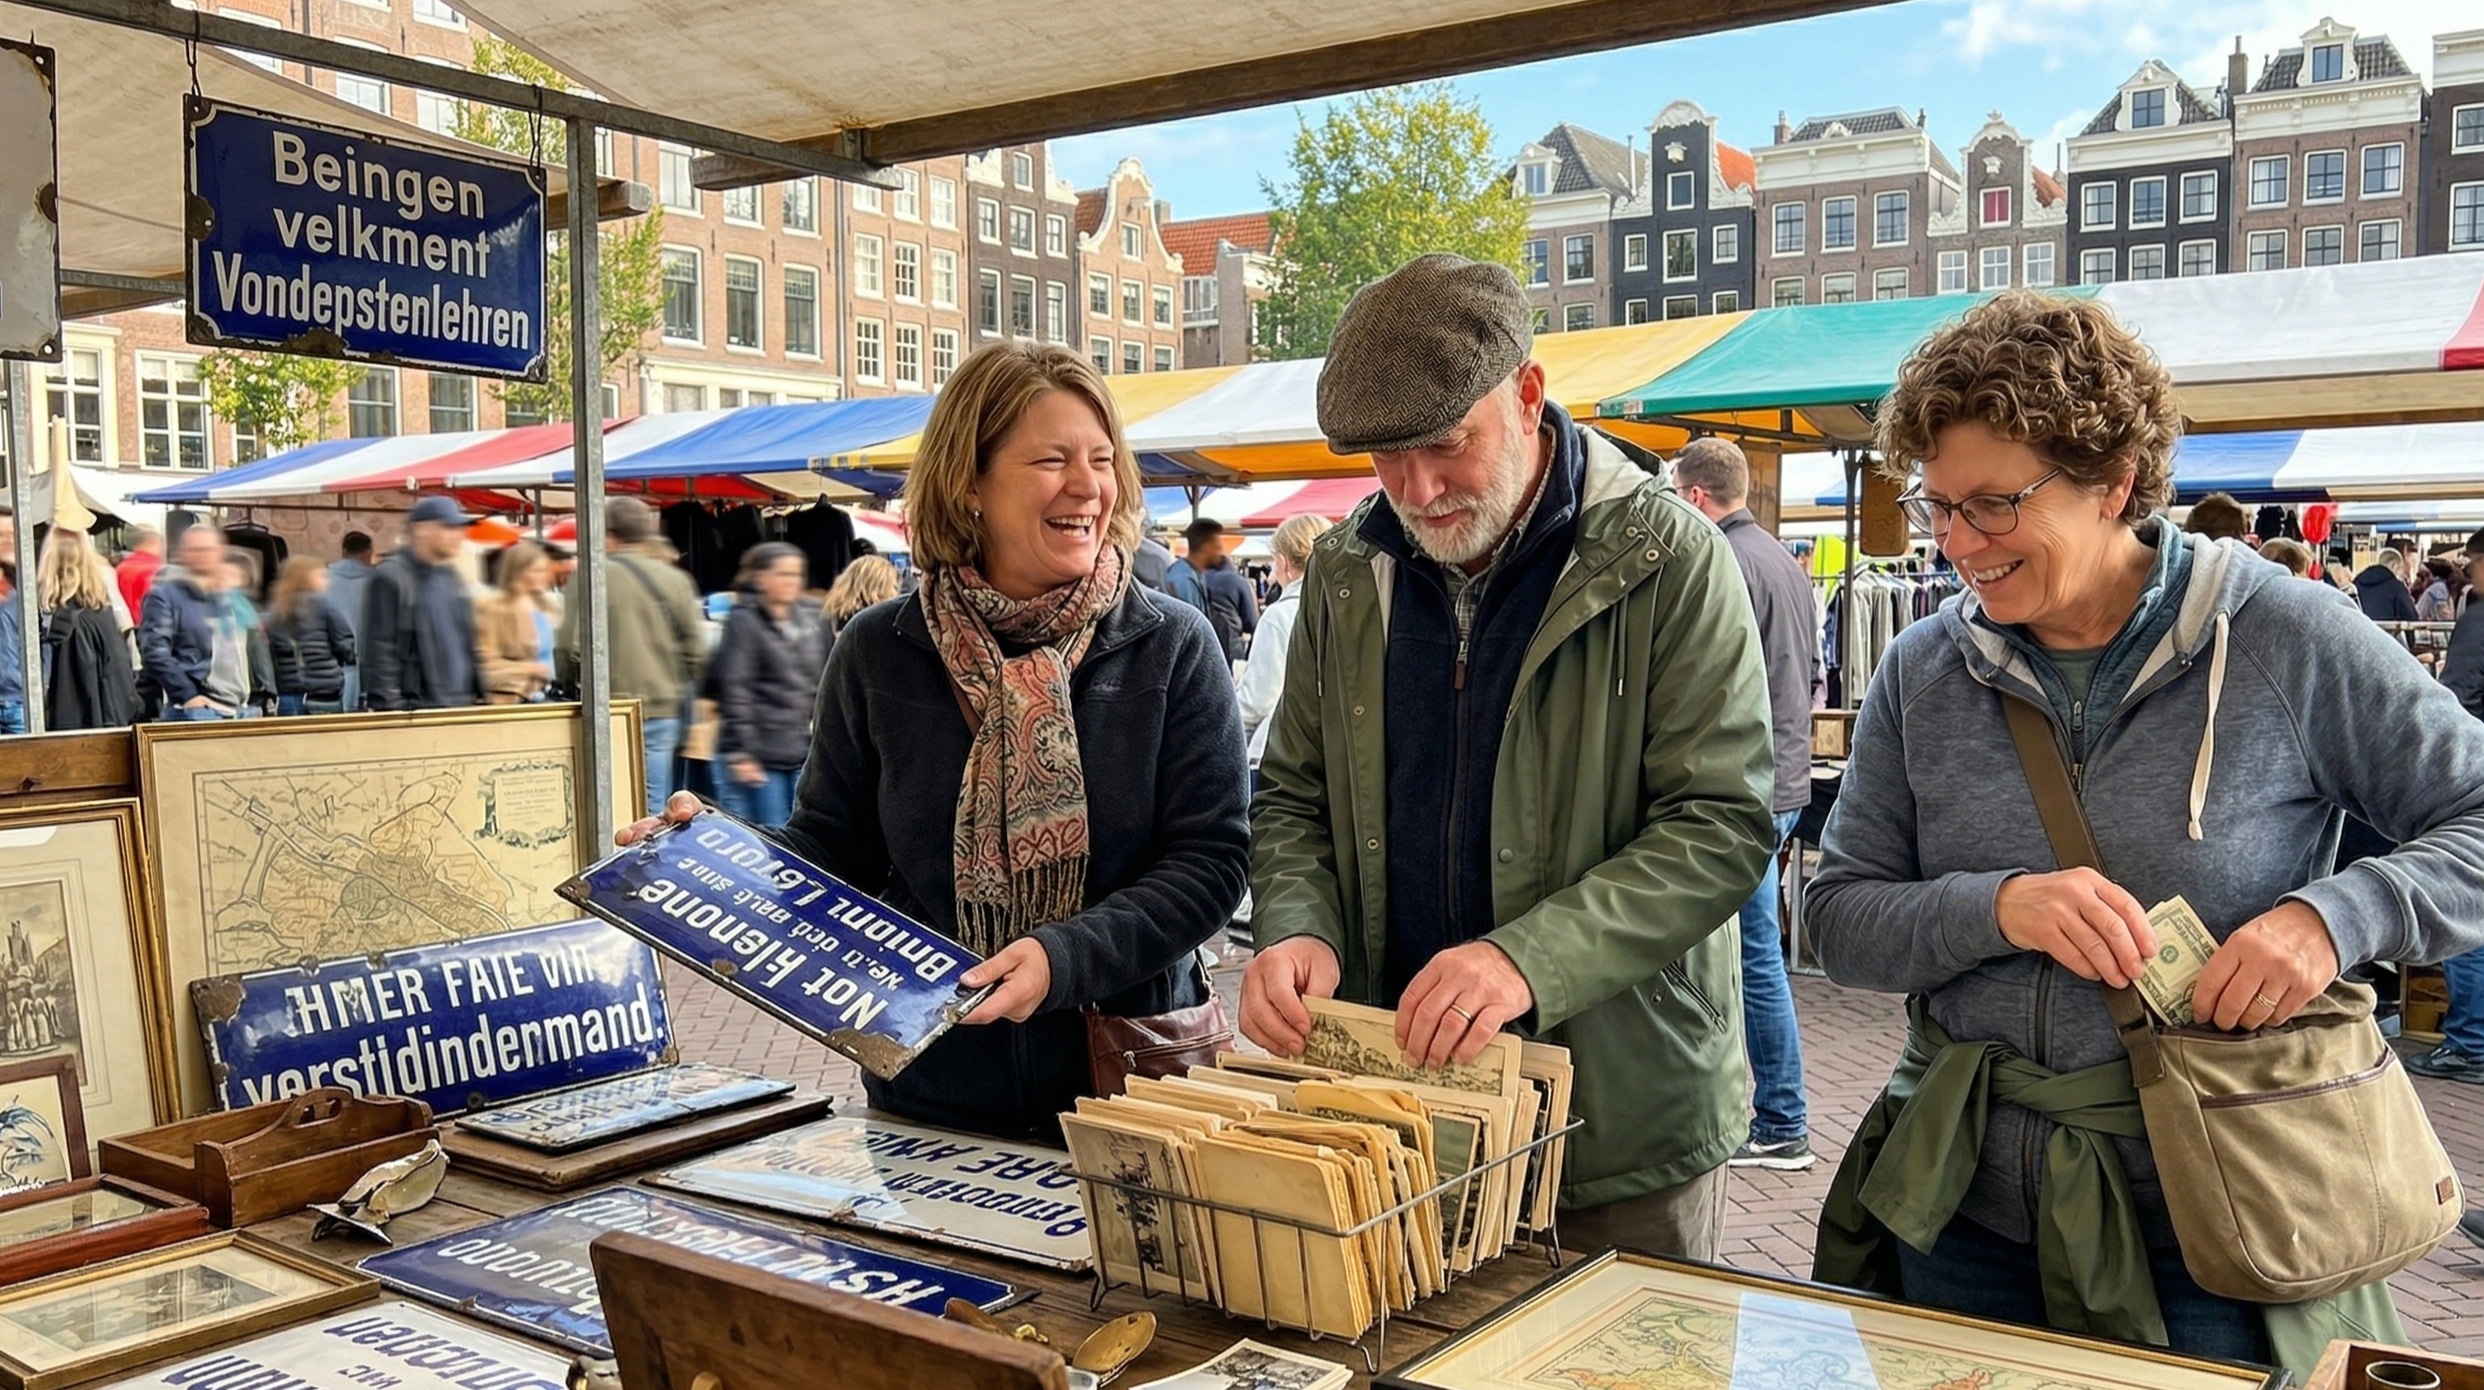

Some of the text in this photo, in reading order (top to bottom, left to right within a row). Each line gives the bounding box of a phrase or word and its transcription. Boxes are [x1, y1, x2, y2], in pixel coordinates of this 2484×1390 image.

[272, 130, 485, 221] Beingen
[272, 203, 491, 279] velkment
[212, 249, 530, 350] Vondepstenlehren
